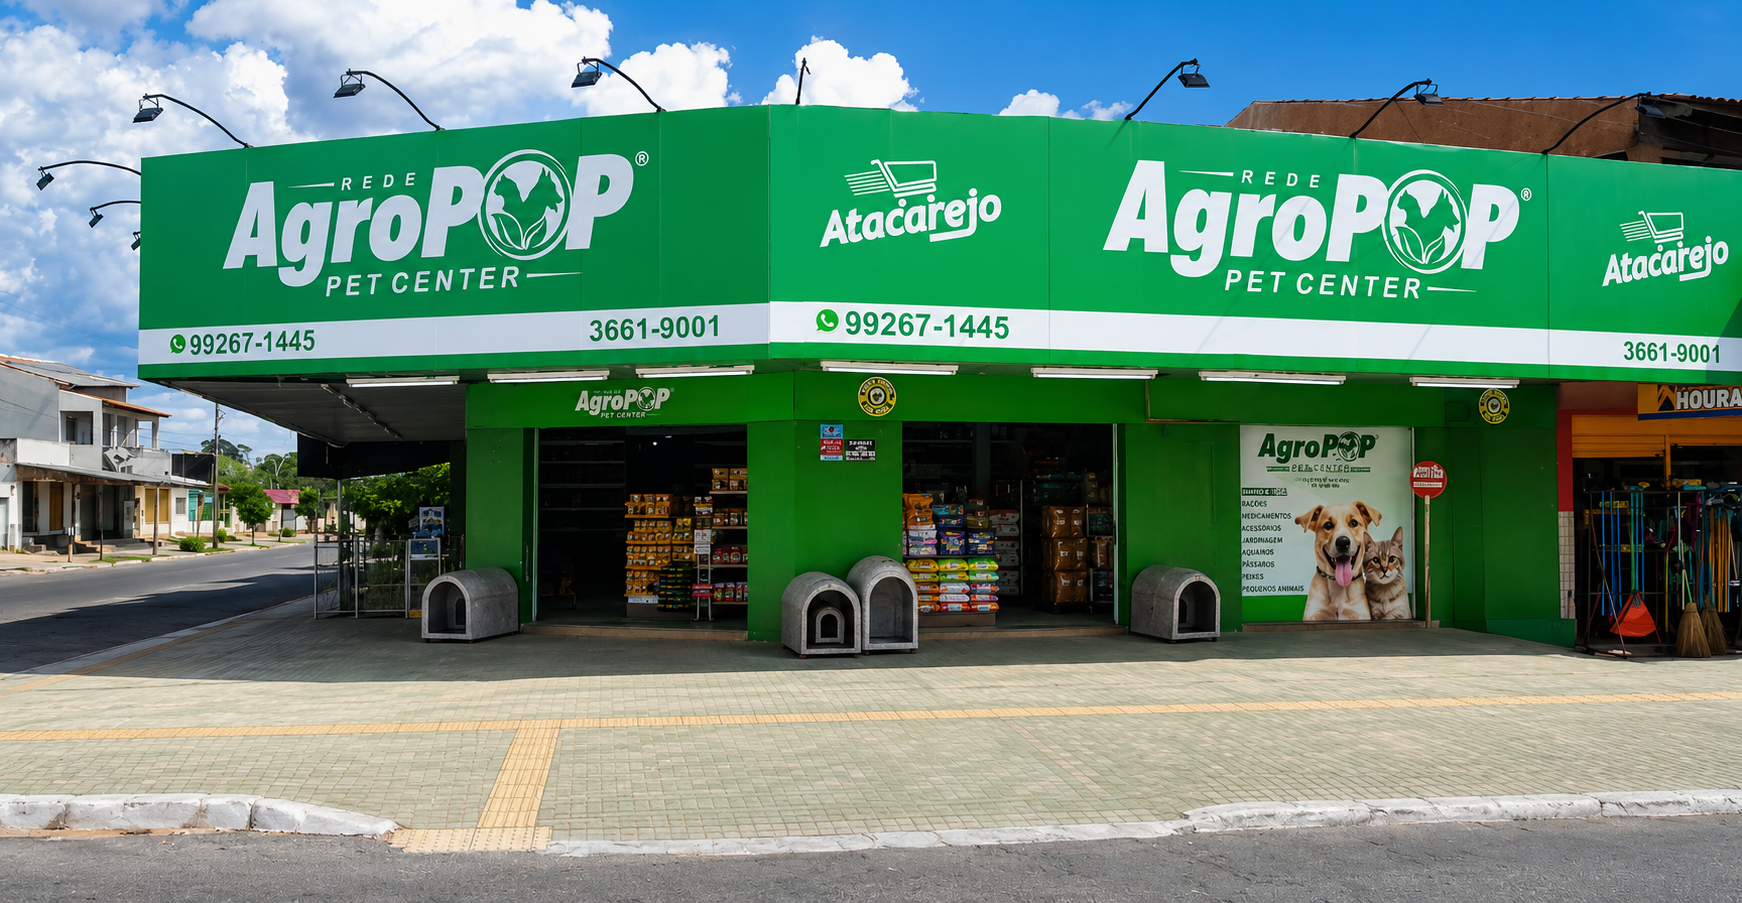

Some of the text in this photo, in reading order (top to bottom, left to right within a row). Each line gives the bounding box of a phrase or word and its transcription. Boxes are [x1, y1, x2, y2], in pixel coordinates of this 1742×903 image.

[341, 172, 416, 191] REDE
[1241, 169, 1321, 188] REDE
[819, 187, 1002, 248] Atacarejo
[1601, 236, 1729, 287] Atacarejo
[325, 265, 520, 297] PET CENTER
[1224, 269, 1420, 299] PET CENTER
[589, 314, 719, 343] 3661-9001
[845, 310, 1010, 340] 99267-1445
[189, 329, 316, 356] 99267-1445
[1623, 341, 1720, 364] 3661-9001
[1676, 387, 1742, 412] HOURA
